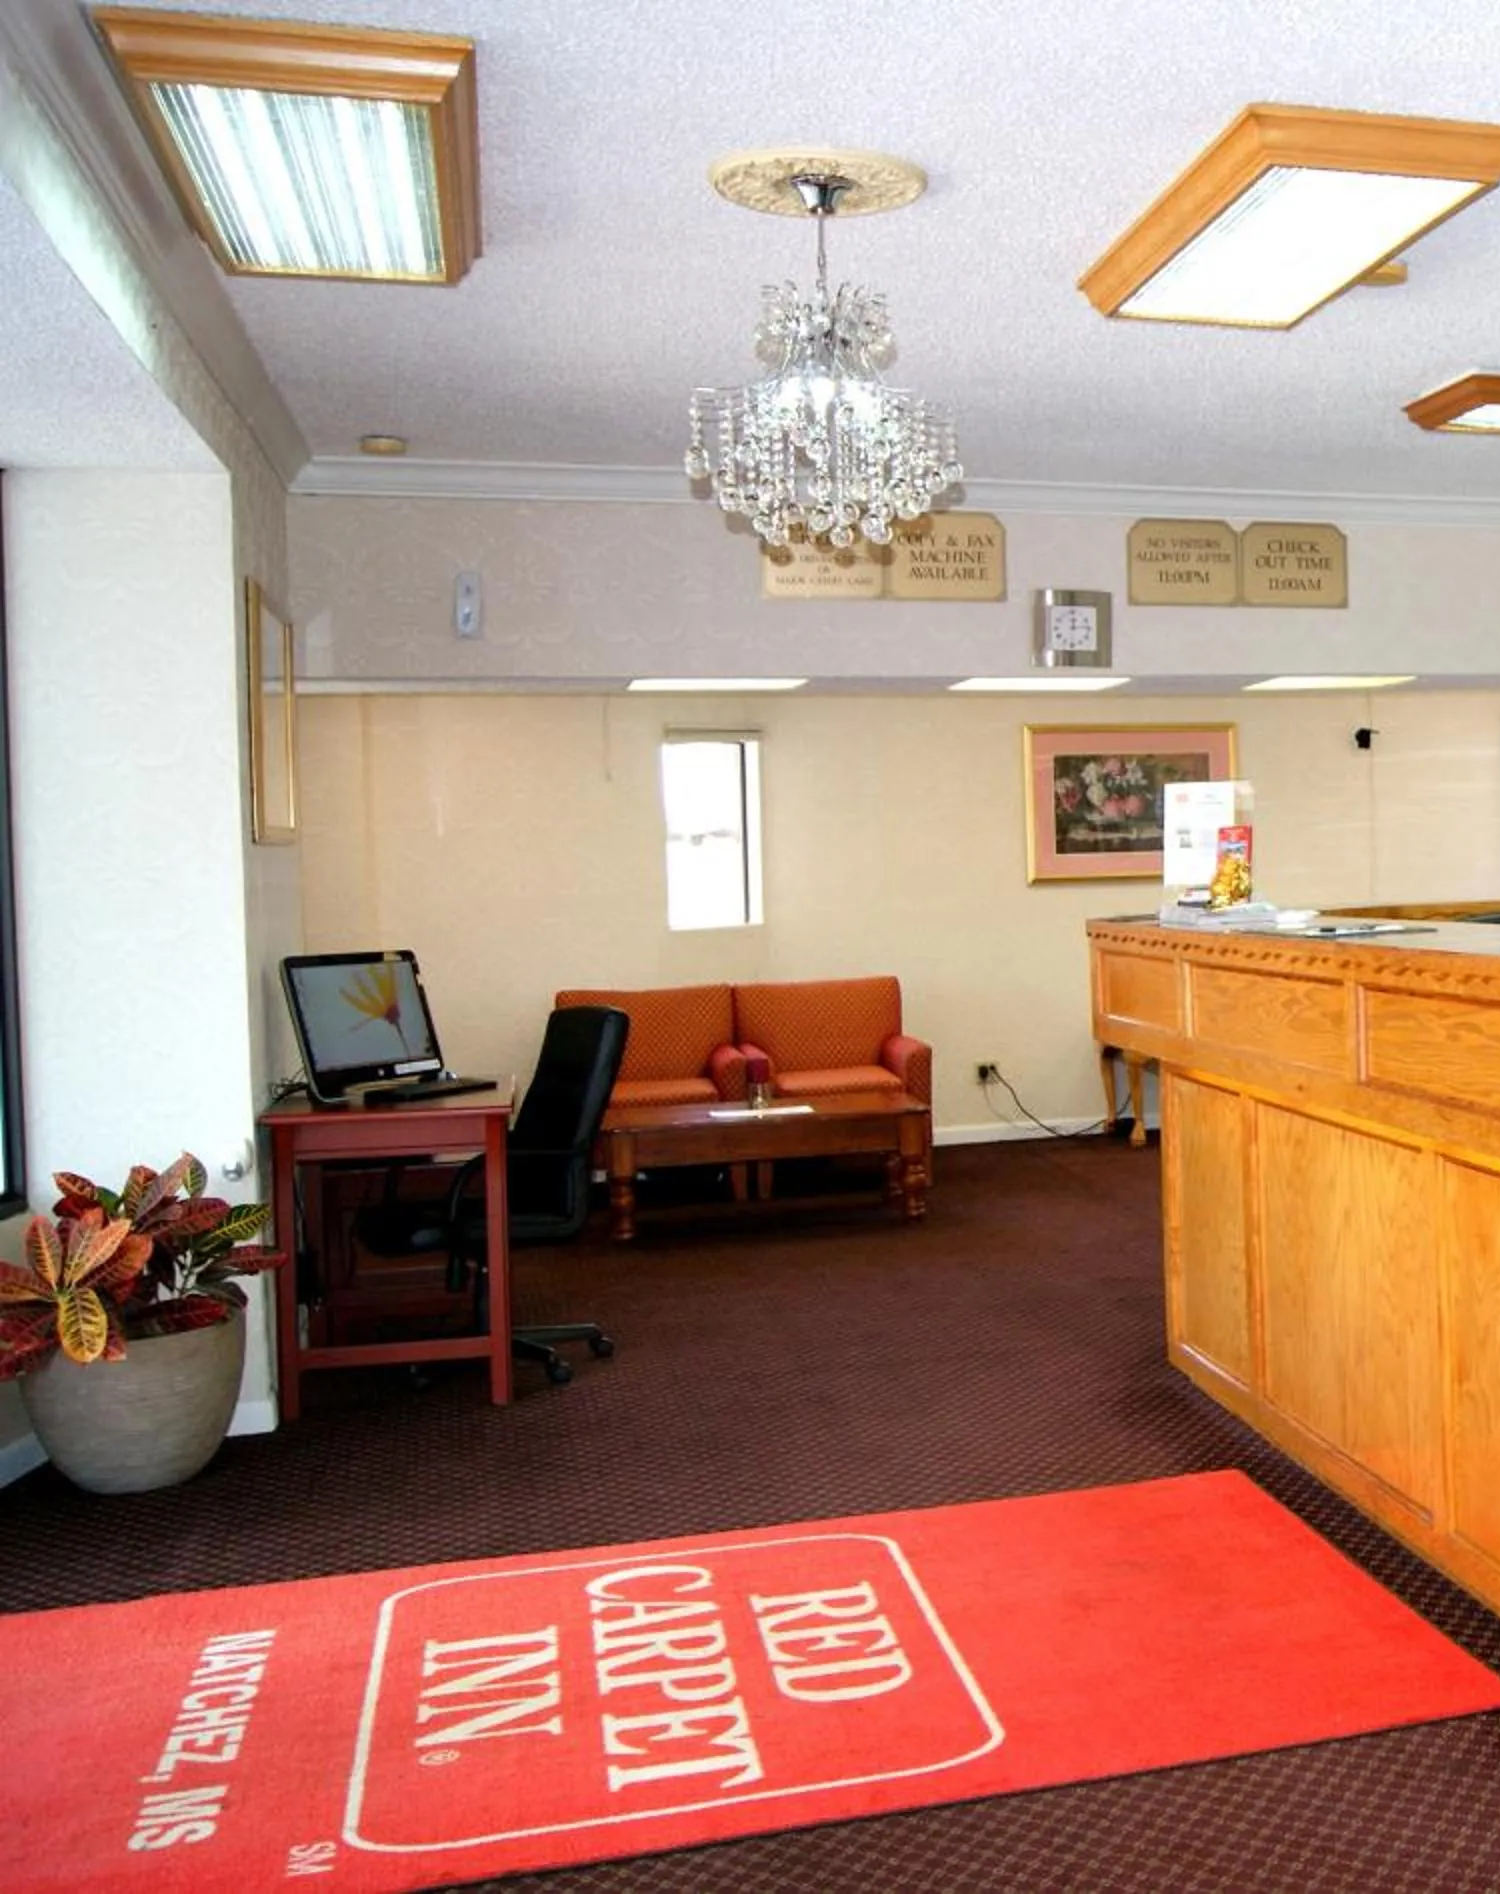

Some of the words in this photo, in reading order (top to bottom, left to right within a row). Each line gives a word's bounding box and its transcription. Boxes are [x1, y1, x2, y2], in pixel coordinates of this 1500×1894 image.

[897, 535, 935, 546] COPY
[945, 535, 959, 547] &
[966, 534, 995, 548] FAX
[1266, 540, 1321, 554] CHECK
[909, 551, 987, 563] MACHINE
[1135, 551, 1190, 563] ALLOWED
[1195, 553, 1232, 563] AFTER
[1255, 555, 1287, 568] OUT
[1296, 556, 1333, 570] TIME
[909, 568, 988, 579] AVAILABLE
[748, 1579, 914, 1702] RED
[584, 1564, 765, 1792] CARPET
[138, 1628, 277, 1784] NATCHEZ,
[127, 1784, 229, 1851] MS
[285, 1841, 337, 1877] SM
